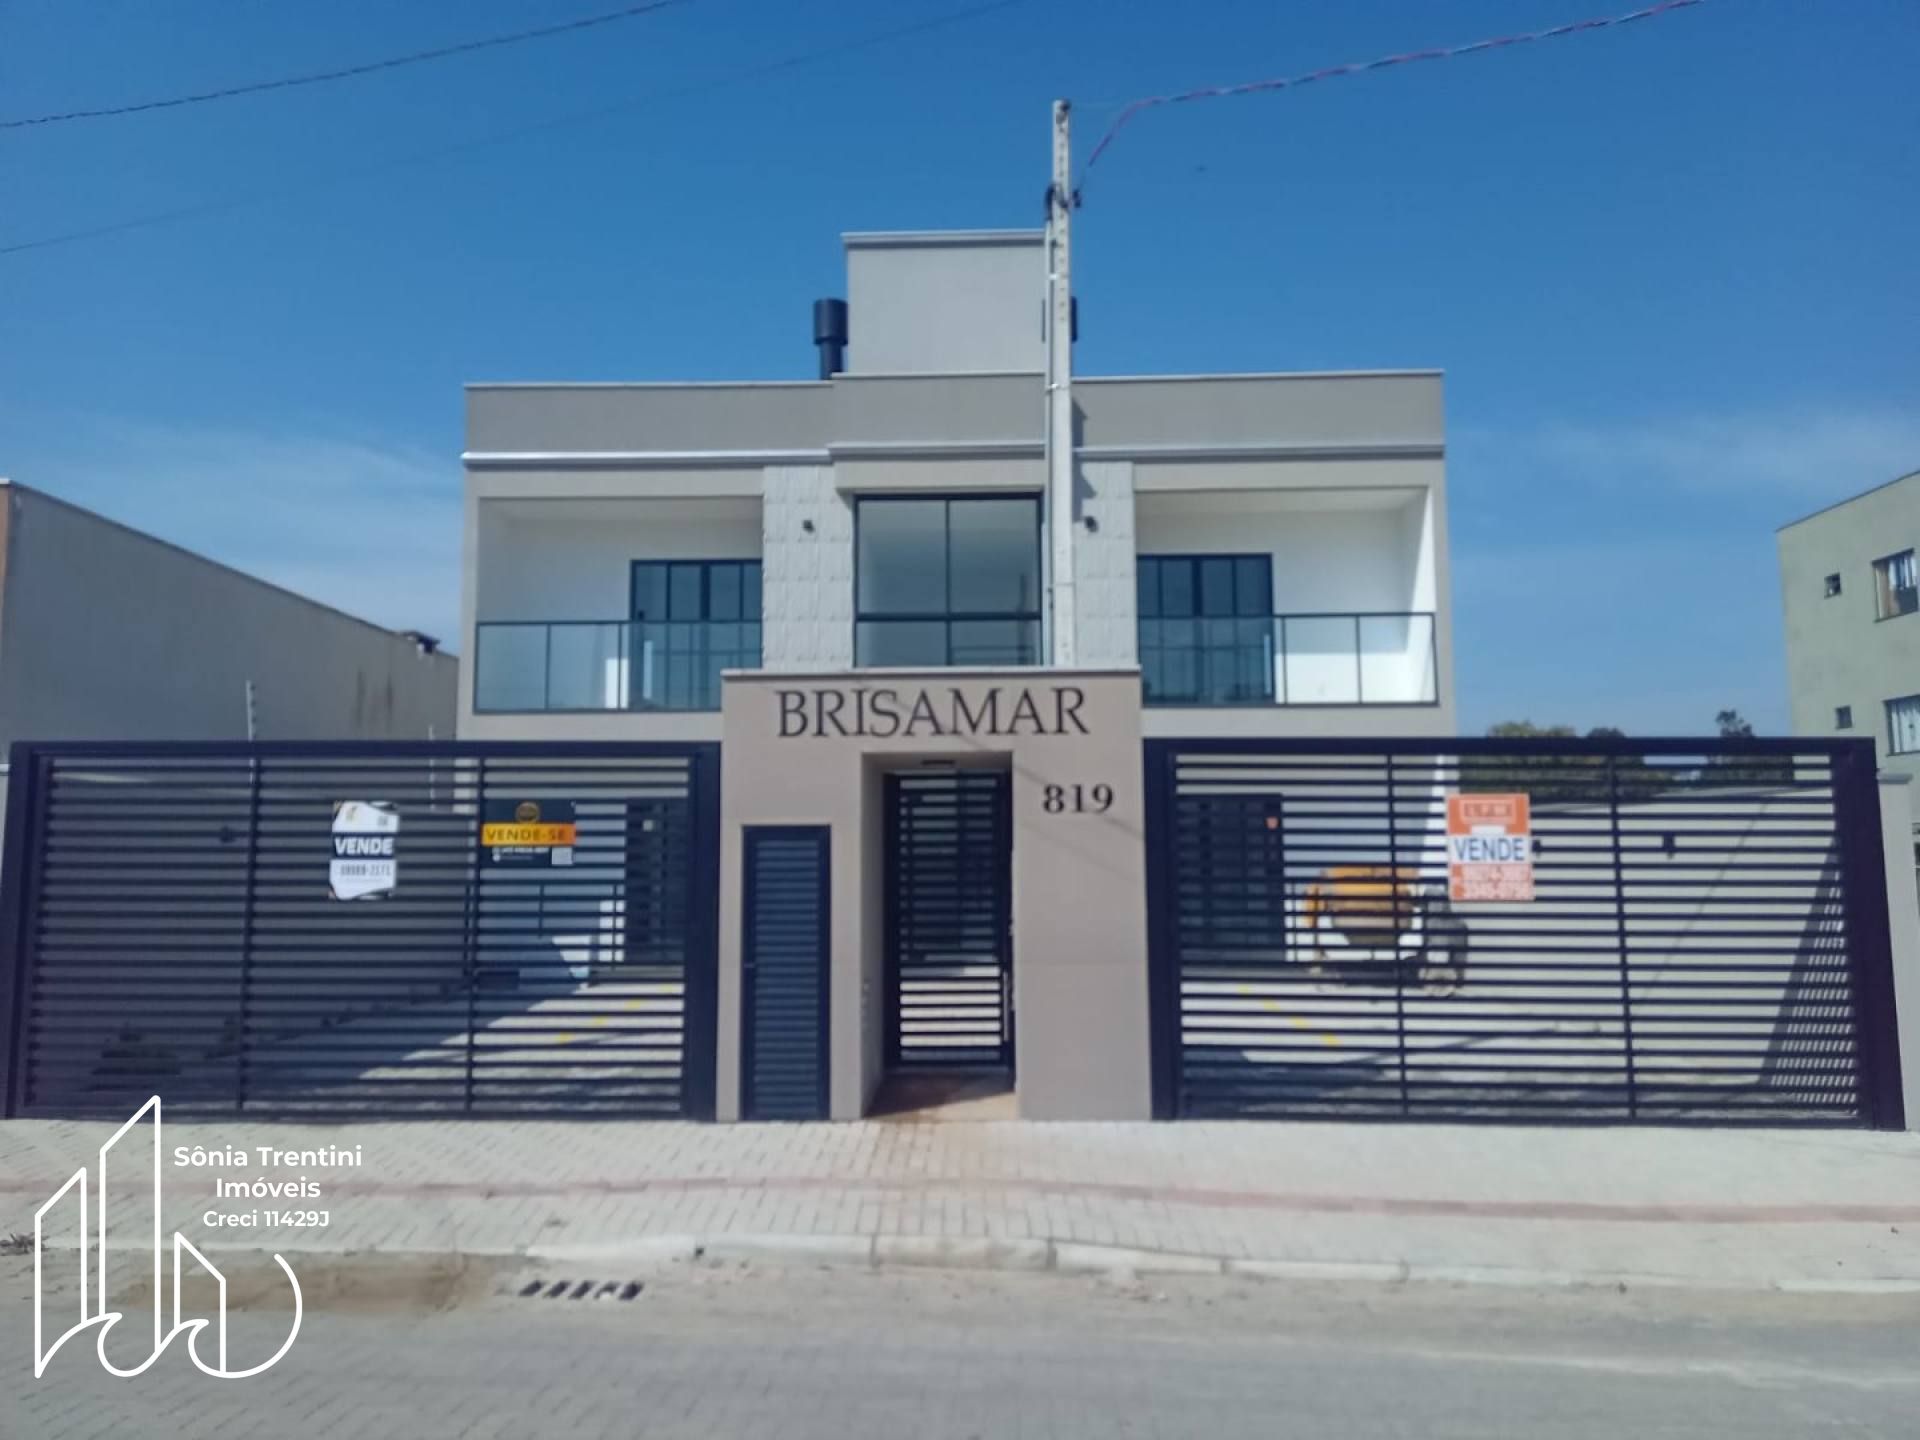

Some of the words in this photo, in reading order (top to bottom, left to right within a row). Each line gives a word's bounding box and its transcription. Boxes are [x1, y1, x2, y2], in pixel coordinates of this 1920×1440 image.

[775, 687, 1090, 738] BRISAMAR
[1042, 783, 1114, 814] 819
[334, 836, 394, 856] VENDE
[486, 827, 567, 842] VENDE-SE
[1454, 837, 1525, 861] VENDE
